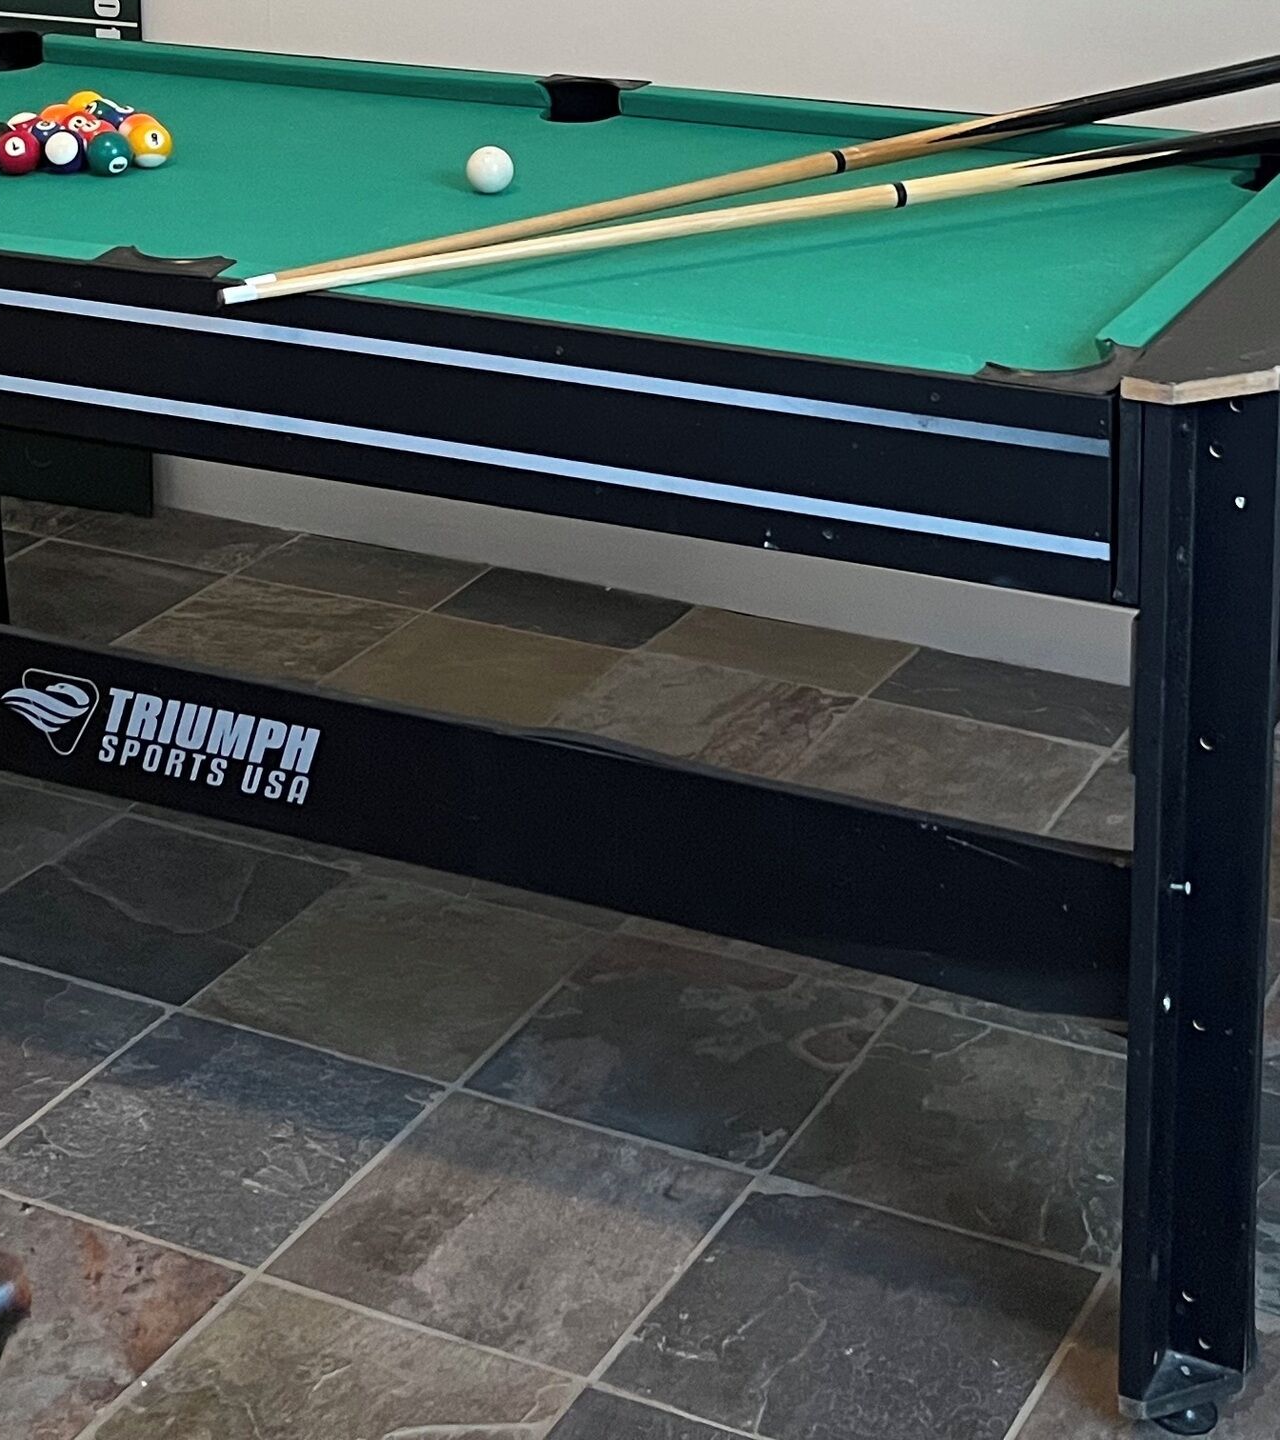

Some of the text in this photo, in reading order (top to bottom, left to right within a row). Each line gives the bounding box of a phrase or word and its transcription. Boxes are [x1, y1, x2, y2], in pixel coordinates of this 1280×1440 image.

[98, 734, 310, 806] SPORTS USA
[104, 687, 321, 775] TRIUMPH
